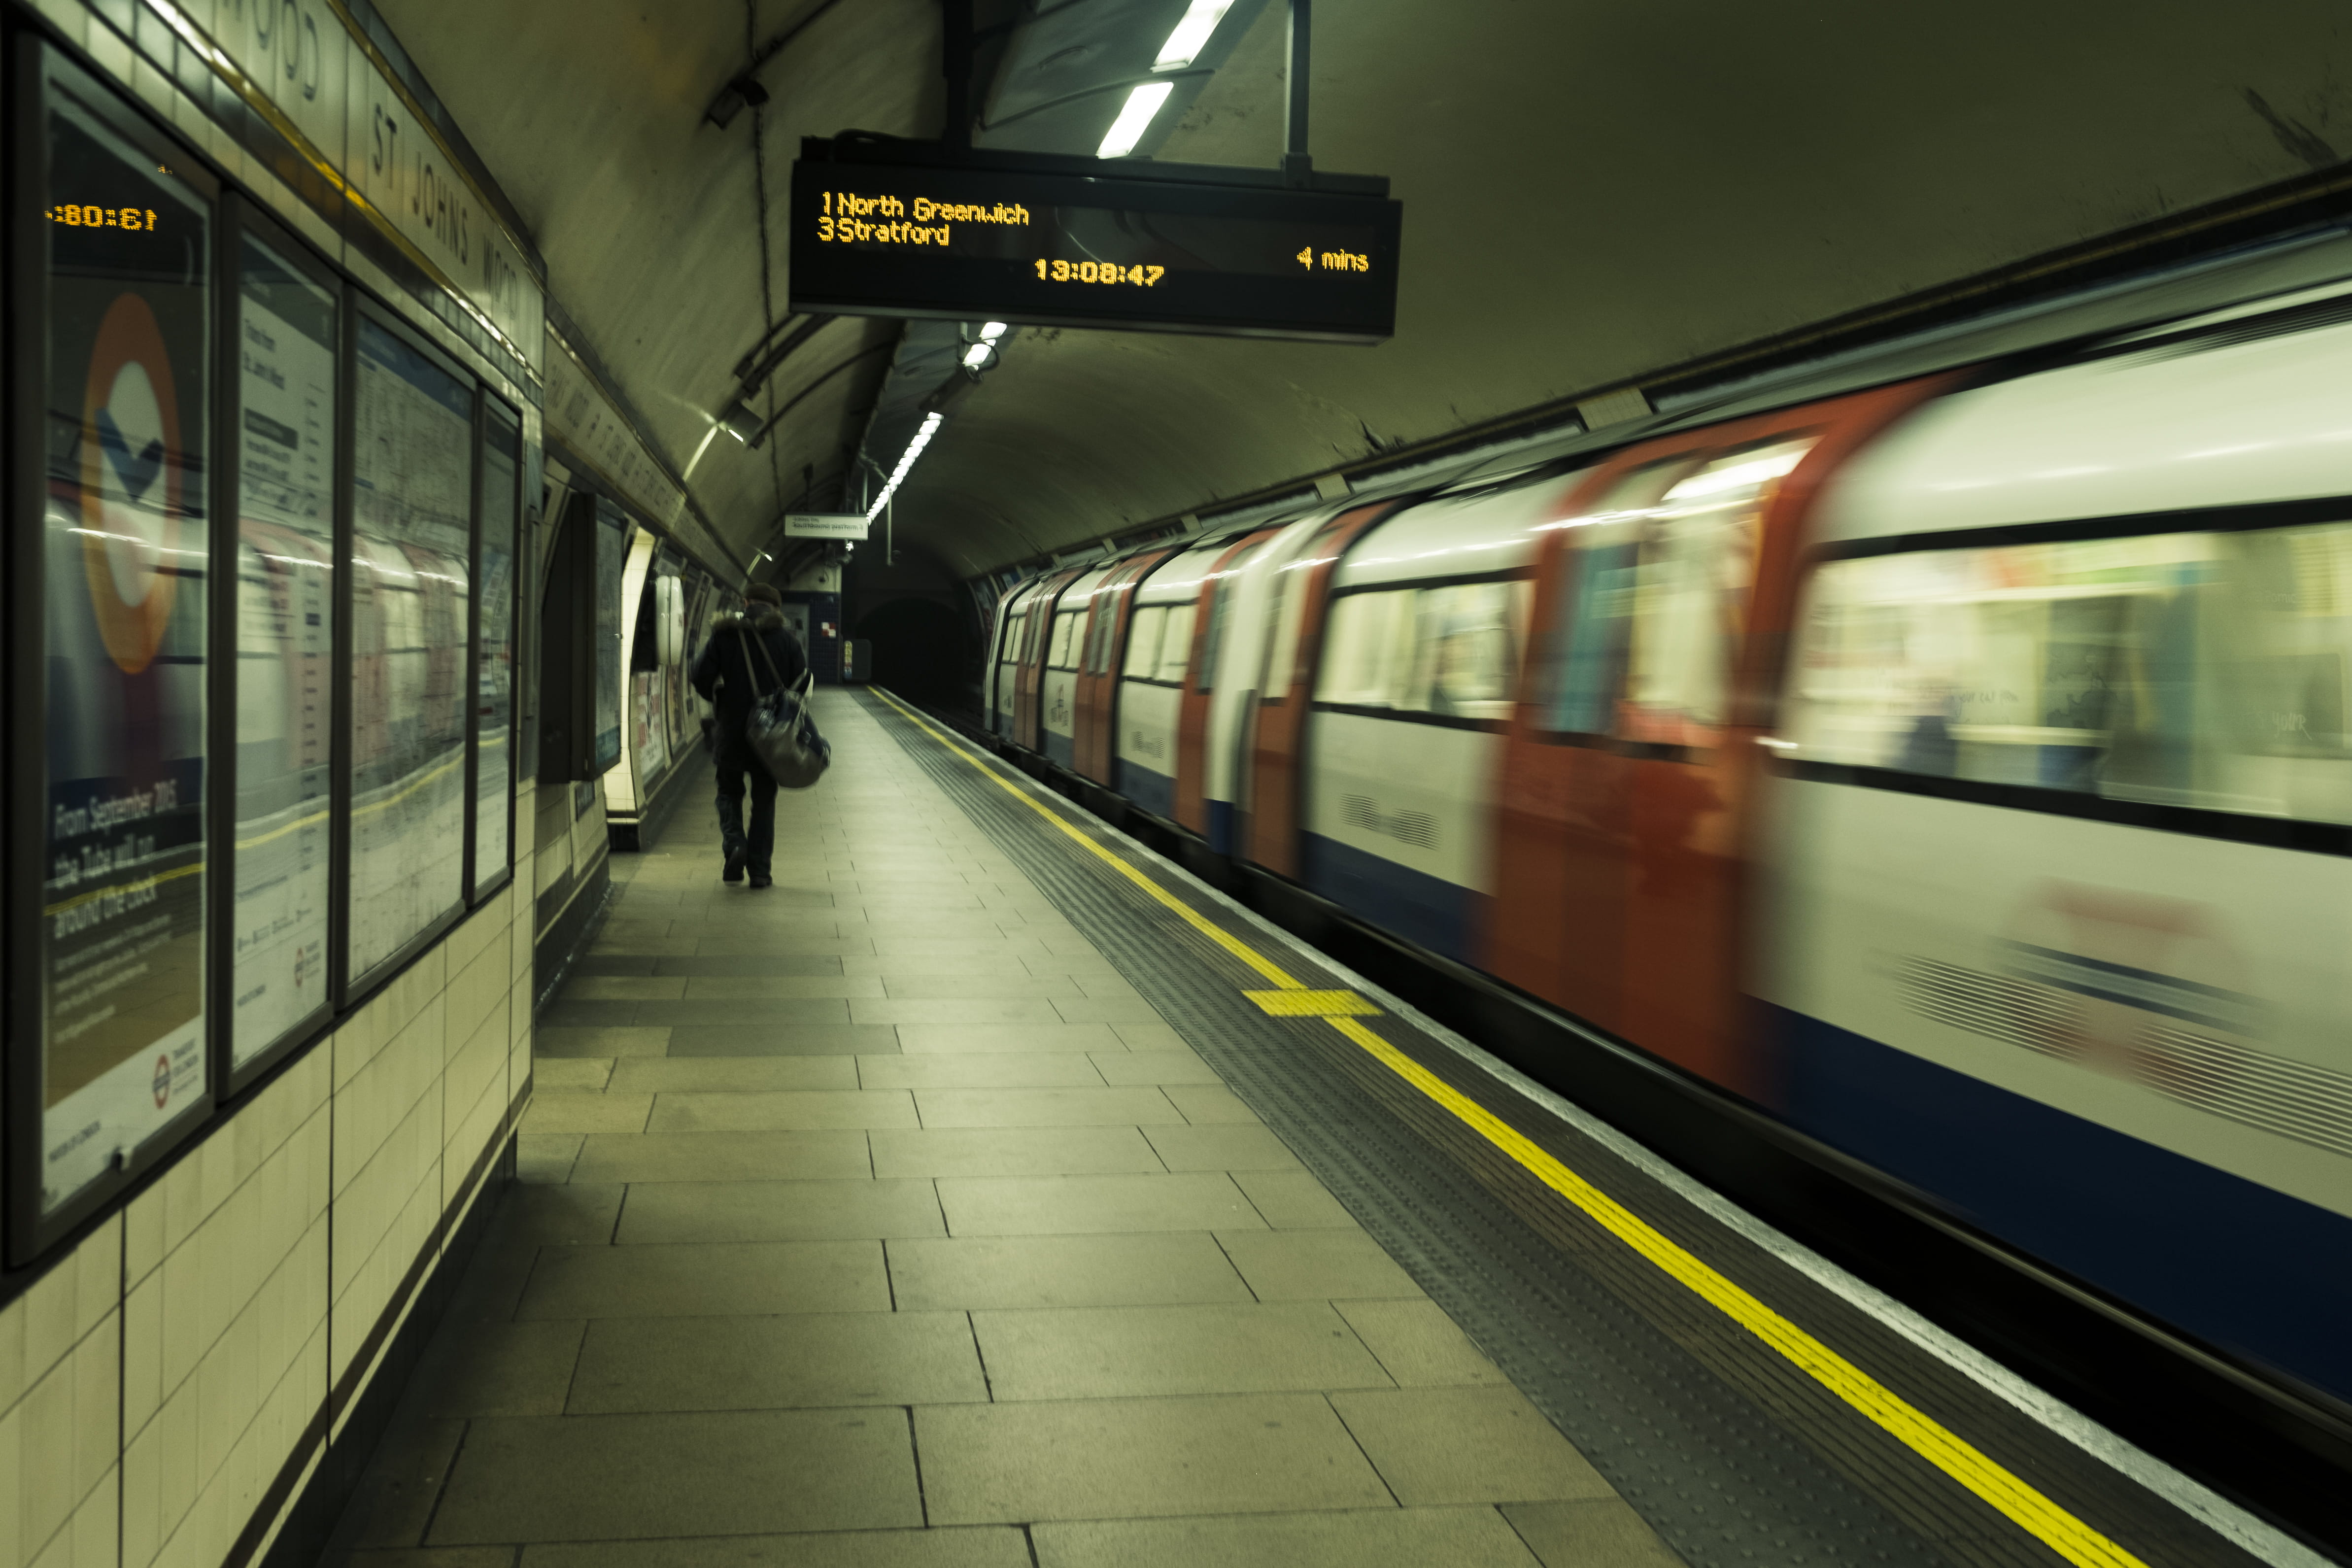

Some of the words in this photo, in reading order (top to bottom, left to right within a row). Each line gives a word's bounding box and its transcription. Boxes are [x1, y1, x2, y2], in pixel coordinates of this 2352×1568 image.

[222, 0, 319, 102] OOD
[372, 102, 398, 190] ST
[412, 151, 468, 266] JOHNS
[483, 233, 518, 321] WOOD
[823, 192, 831, 215] 1
[837, 193, 904, 217] North
[913, 198, 1029, 225] Greenwich
[837, 218, 950, 246] Stratford
[1297, 247, 1313, 271] 4
[1322, 249, 1368, 272] mins
[1035, 259, 1164, 287] 13:08:47
[54, 803, 87, 840] From
[90, 786, 153, 837] September
